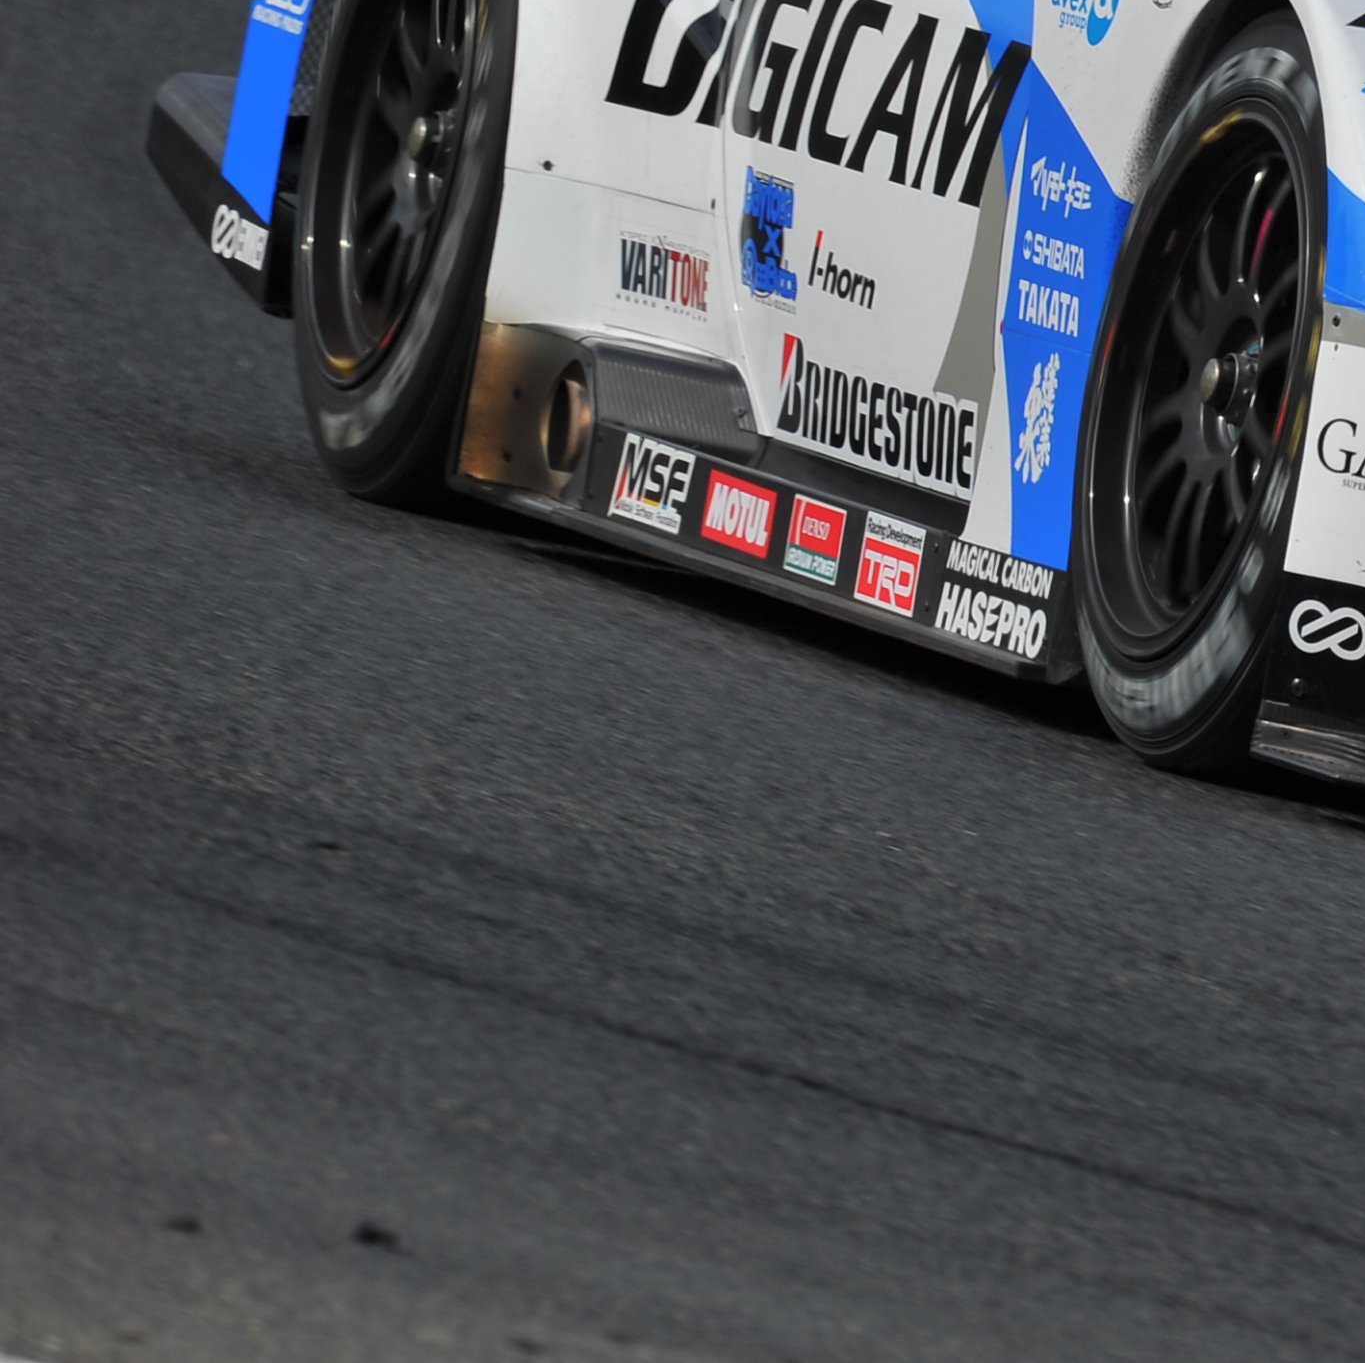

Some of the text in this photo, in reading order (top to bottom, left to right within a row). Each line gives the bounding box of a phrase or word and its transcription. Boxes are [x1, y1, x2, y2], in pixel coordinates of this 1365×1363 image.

[1059, 11, 1087, 34] group
[621, 237, 709, 313] VARITONE
[807, 228, 876, 311] I-horn
[1032, 232, 1085, 280] SHIBATA
[1017, 278, 1080, 338] TAKATA
[777, 332, 974, 491] BRIDGESTONE
[705, 481, 770, 548] MOTUL
[802, 515, 831, 542] DENSO
[864, 548, 915, 606] TRD
[946, 539, 1054, 600] MAGICAL CARBON
[934, 580, 1047, 659] HASEPRO
